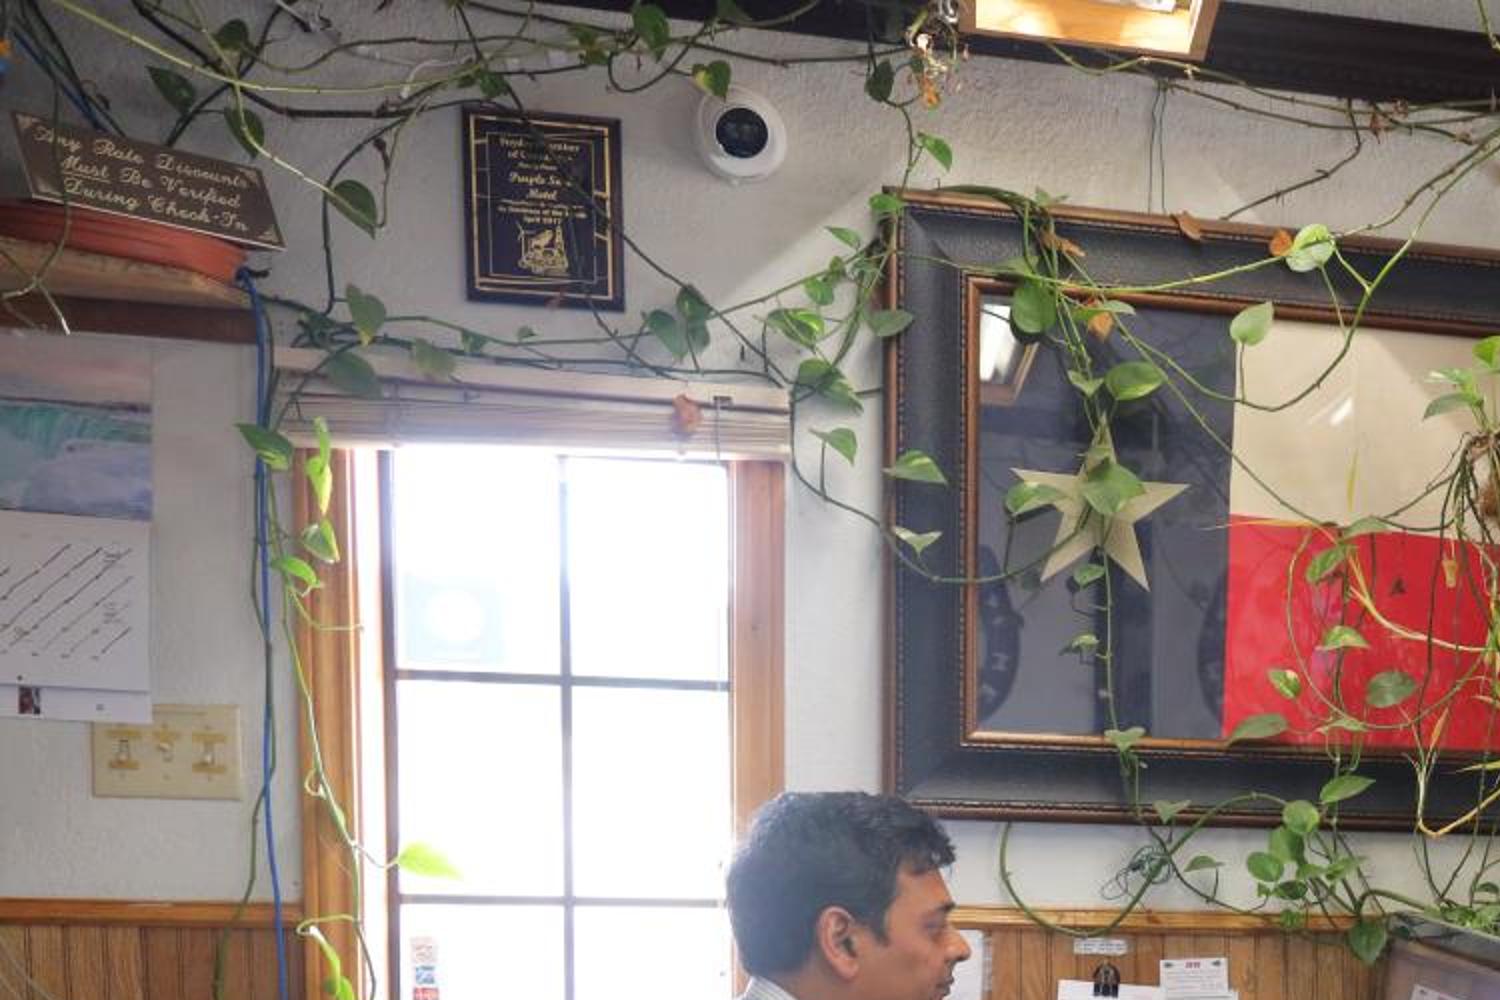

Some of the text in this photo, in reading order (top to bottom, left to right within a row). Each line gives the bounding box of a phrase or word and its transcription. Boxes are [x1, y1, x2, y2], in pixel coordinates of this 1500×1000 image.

[61, 155, 110, 179] Must
[119, 167, 153, 189] Be
[64, 178, 140, 212] During
